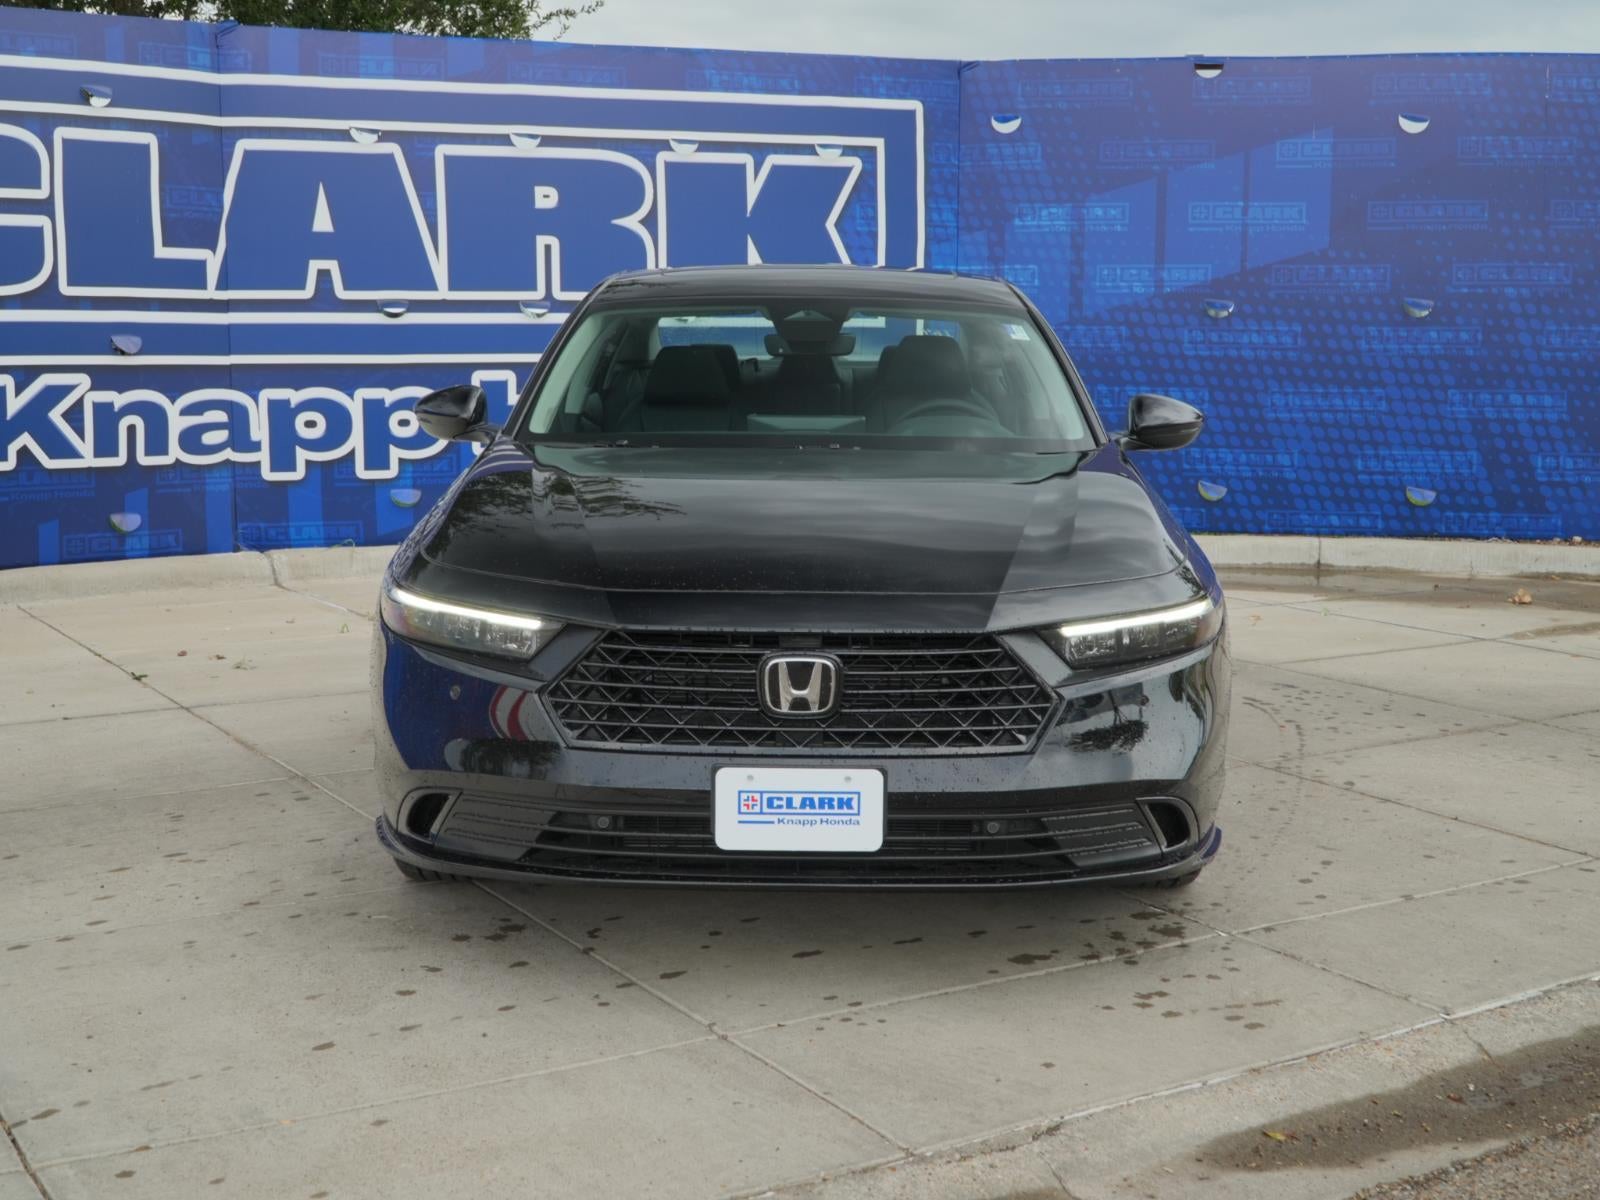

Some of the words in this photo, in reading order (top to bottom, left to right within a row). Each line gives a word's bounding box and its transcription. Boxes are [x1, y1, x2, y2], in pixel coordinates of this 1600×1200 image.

[0, 122, 863, 300] LARK
[1213, 206, 1302, 220] CLARK
[1393, 205, 1485, 219] CLARK
[0, 373, 456, 481] Knapp
[766, 796, 855, 810] CLARK
[777, 817, 817, 827] Knapp
[819, 817, 860, 826] Honda
